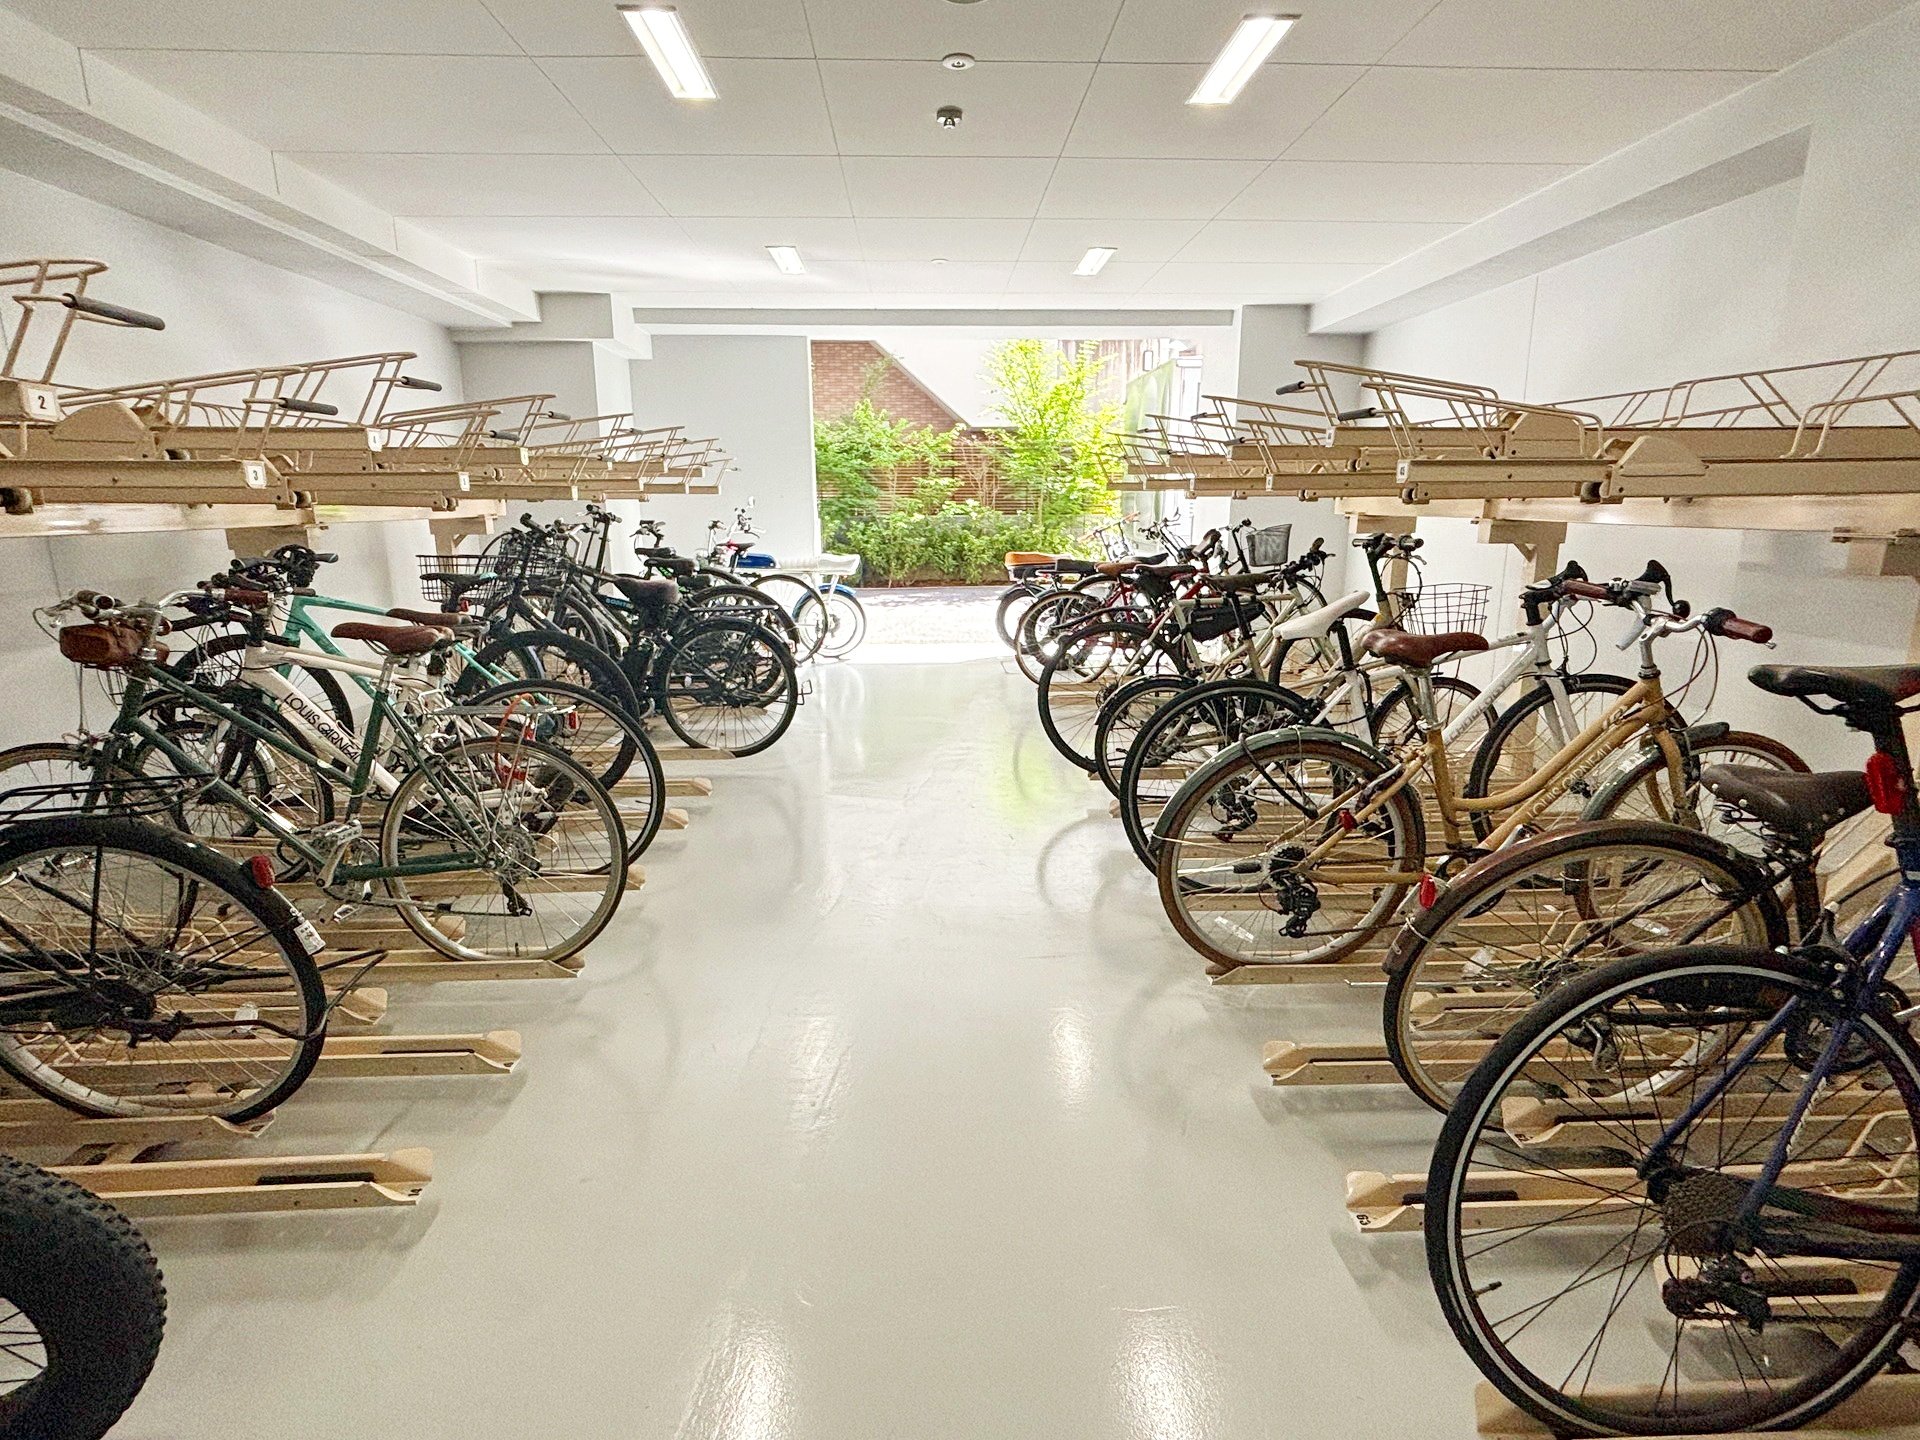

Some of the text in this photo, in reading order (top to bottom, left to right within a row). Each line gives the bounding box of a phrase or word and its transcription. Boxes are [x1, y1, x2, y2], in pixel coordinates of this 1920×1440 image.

[38, 395, 47, 410] 2
[252, 469, 259, 481] 3
[284, 692, 321, 725] LOUIS
[1526, 786, 1560, 819] LOUIS
[1356, 1214, 1372, 1226] 63
